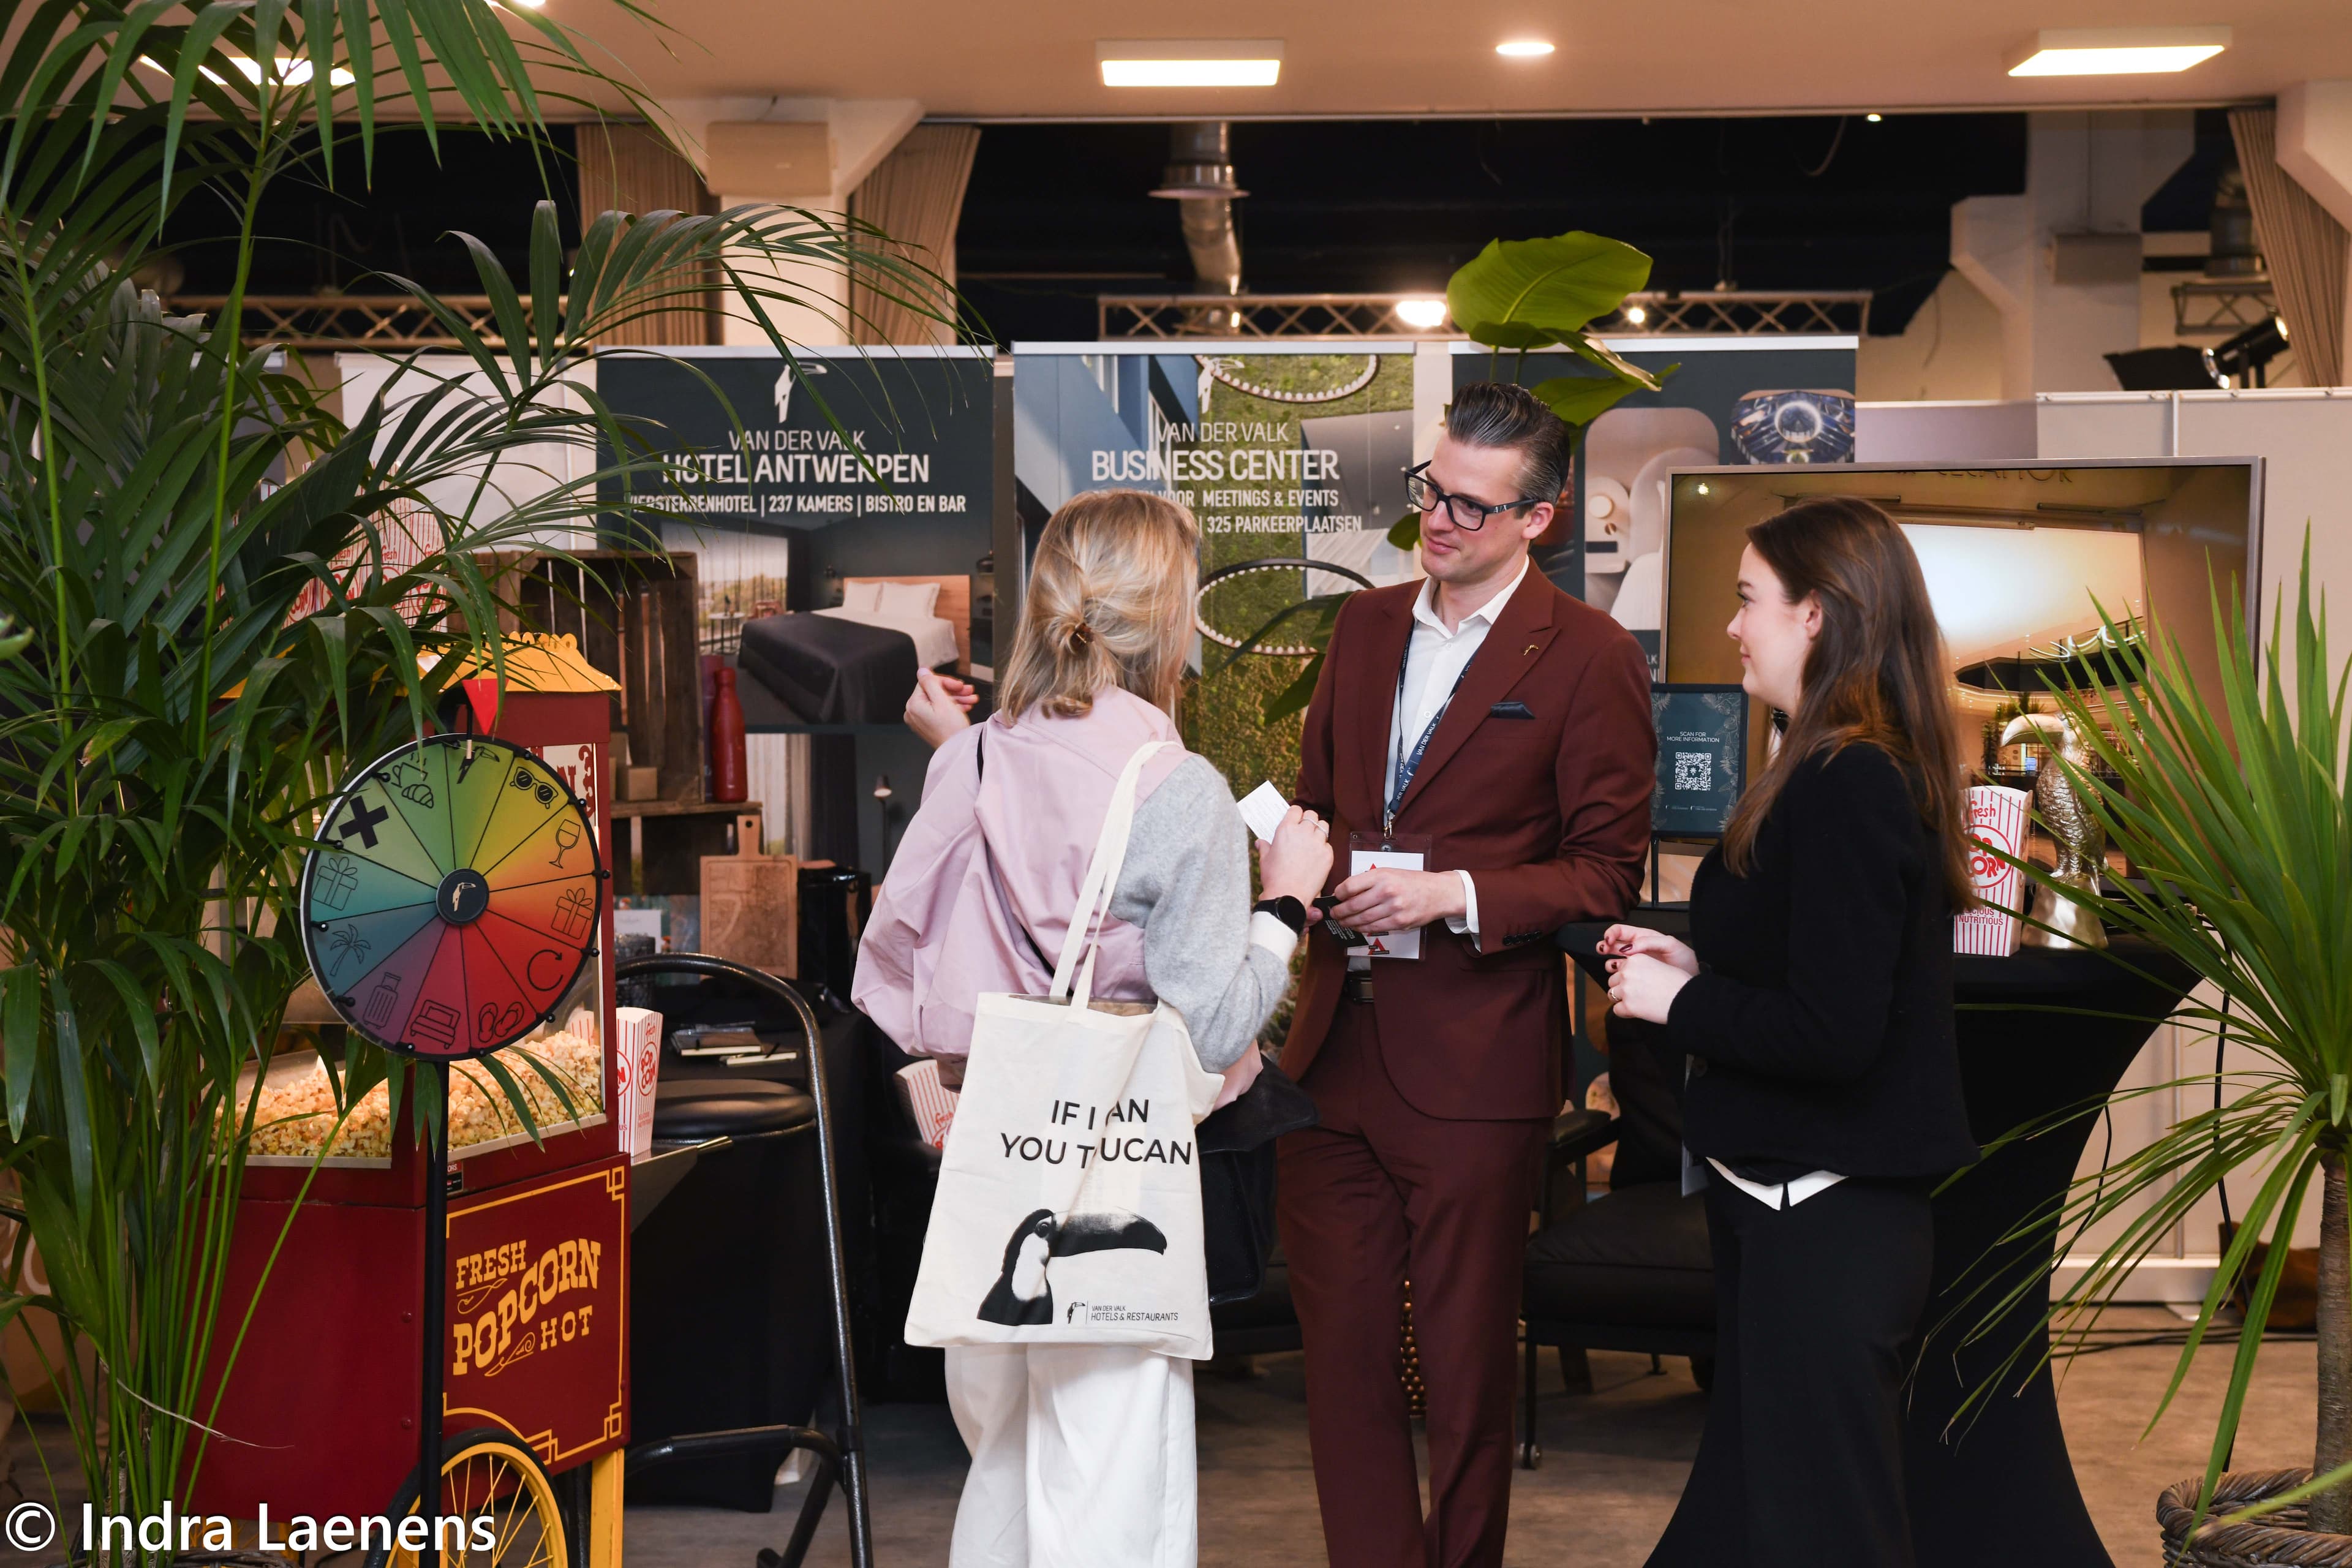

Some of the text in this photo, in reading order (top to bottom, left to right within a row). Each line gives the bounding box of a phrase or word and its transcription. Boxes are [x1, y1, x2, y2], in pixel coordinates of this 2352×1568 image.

[728, 430, 769, 451] VAN
[774, 430, 814, 451] DER
[1158, 422, 1289, 443] VAN DER VALK
[662, 454, 930, 484] HOTEL ANTWERPEN
[1091, 450, 1341, 481] BUSINESS CENTER
[769, 495, 793, 513] 237
[797, 495, 854, 513] KAMERS
[865, 495, 914, 513] BISTRO
[917, 495, 935, 513] EN
[939, 495, 967, 513] BAR
[1203, 489, 1270, 507] MEETINGS
[1273, 491, 1284, 507] &
[1288, 489, 1339, 507] EVENTS
[1207, 515, 1362, 533] 325 PARKEERPLAATSEN
[1416, 745, 1425, 756] VAN
[1427, 723, 1437, 736] VALK
[1400, 778, 1411, 793] VALK
[1969, 854, 2006, 878] ORN
[1959, 915, 2003, 925] NUTRITIOUS
[1050, 1099, 1080, 1125] IF
[1087, 1106, 1096, 1131] I
[1000, 1132, 1192, 1169] YOU TUCAN
[456, 1239, 527, 1290] FRESH
[453, 1238, 601, 1376] POPCORN
[1091, 1312, 1118, 1321] HOTELS
[1126, 1312, 1178, 1321] RESTAURANTS
[540, 1305, 593, 1351] HOT
